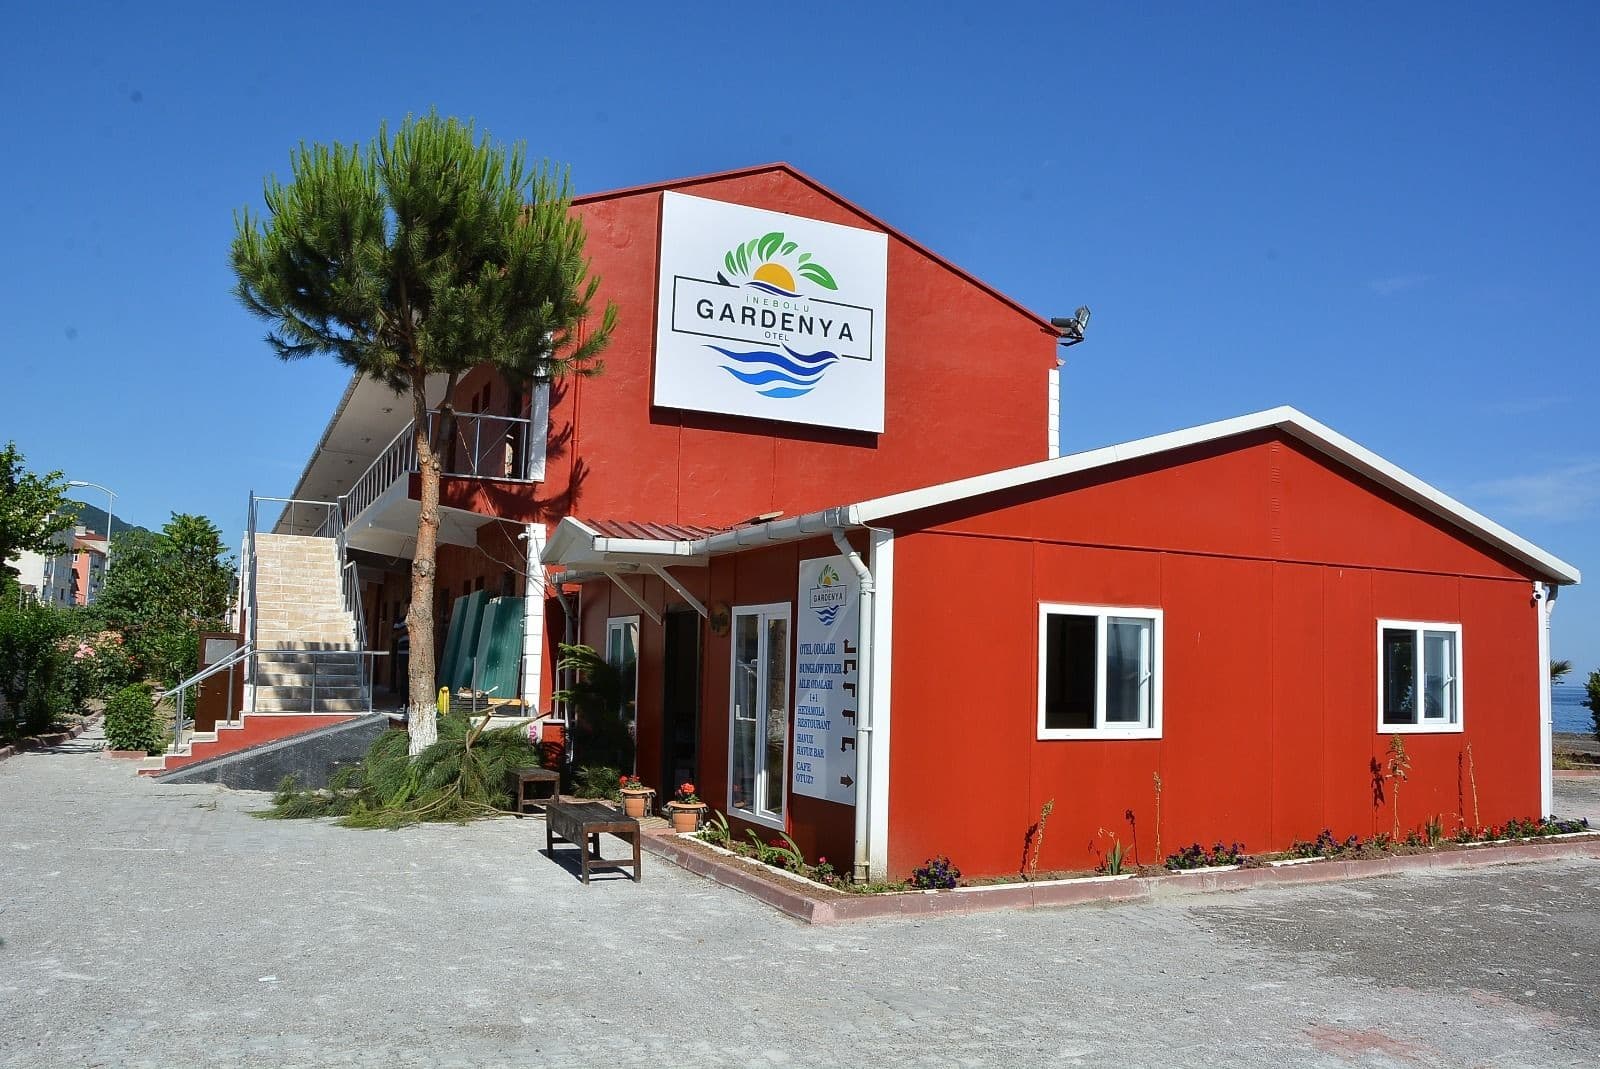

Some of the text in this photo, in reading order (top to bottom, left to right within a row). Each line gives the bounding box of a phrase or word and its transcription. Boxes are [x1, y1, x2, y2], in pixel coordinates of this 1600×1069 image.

[696, 299, 854, 342] GARDENYA
[764, 331, 790, 342] OTEL
[813, 593, 843, 603] GARDENYA
[800, 643, 836, 655] OTEL ODALARI
[824, 663, 842, 674] EVLER
[811, 679, 833, 690] ODALARI
[796, 746, 825, 758] HAVUZ BAR
[795, 761, 812, 772] CAFE
